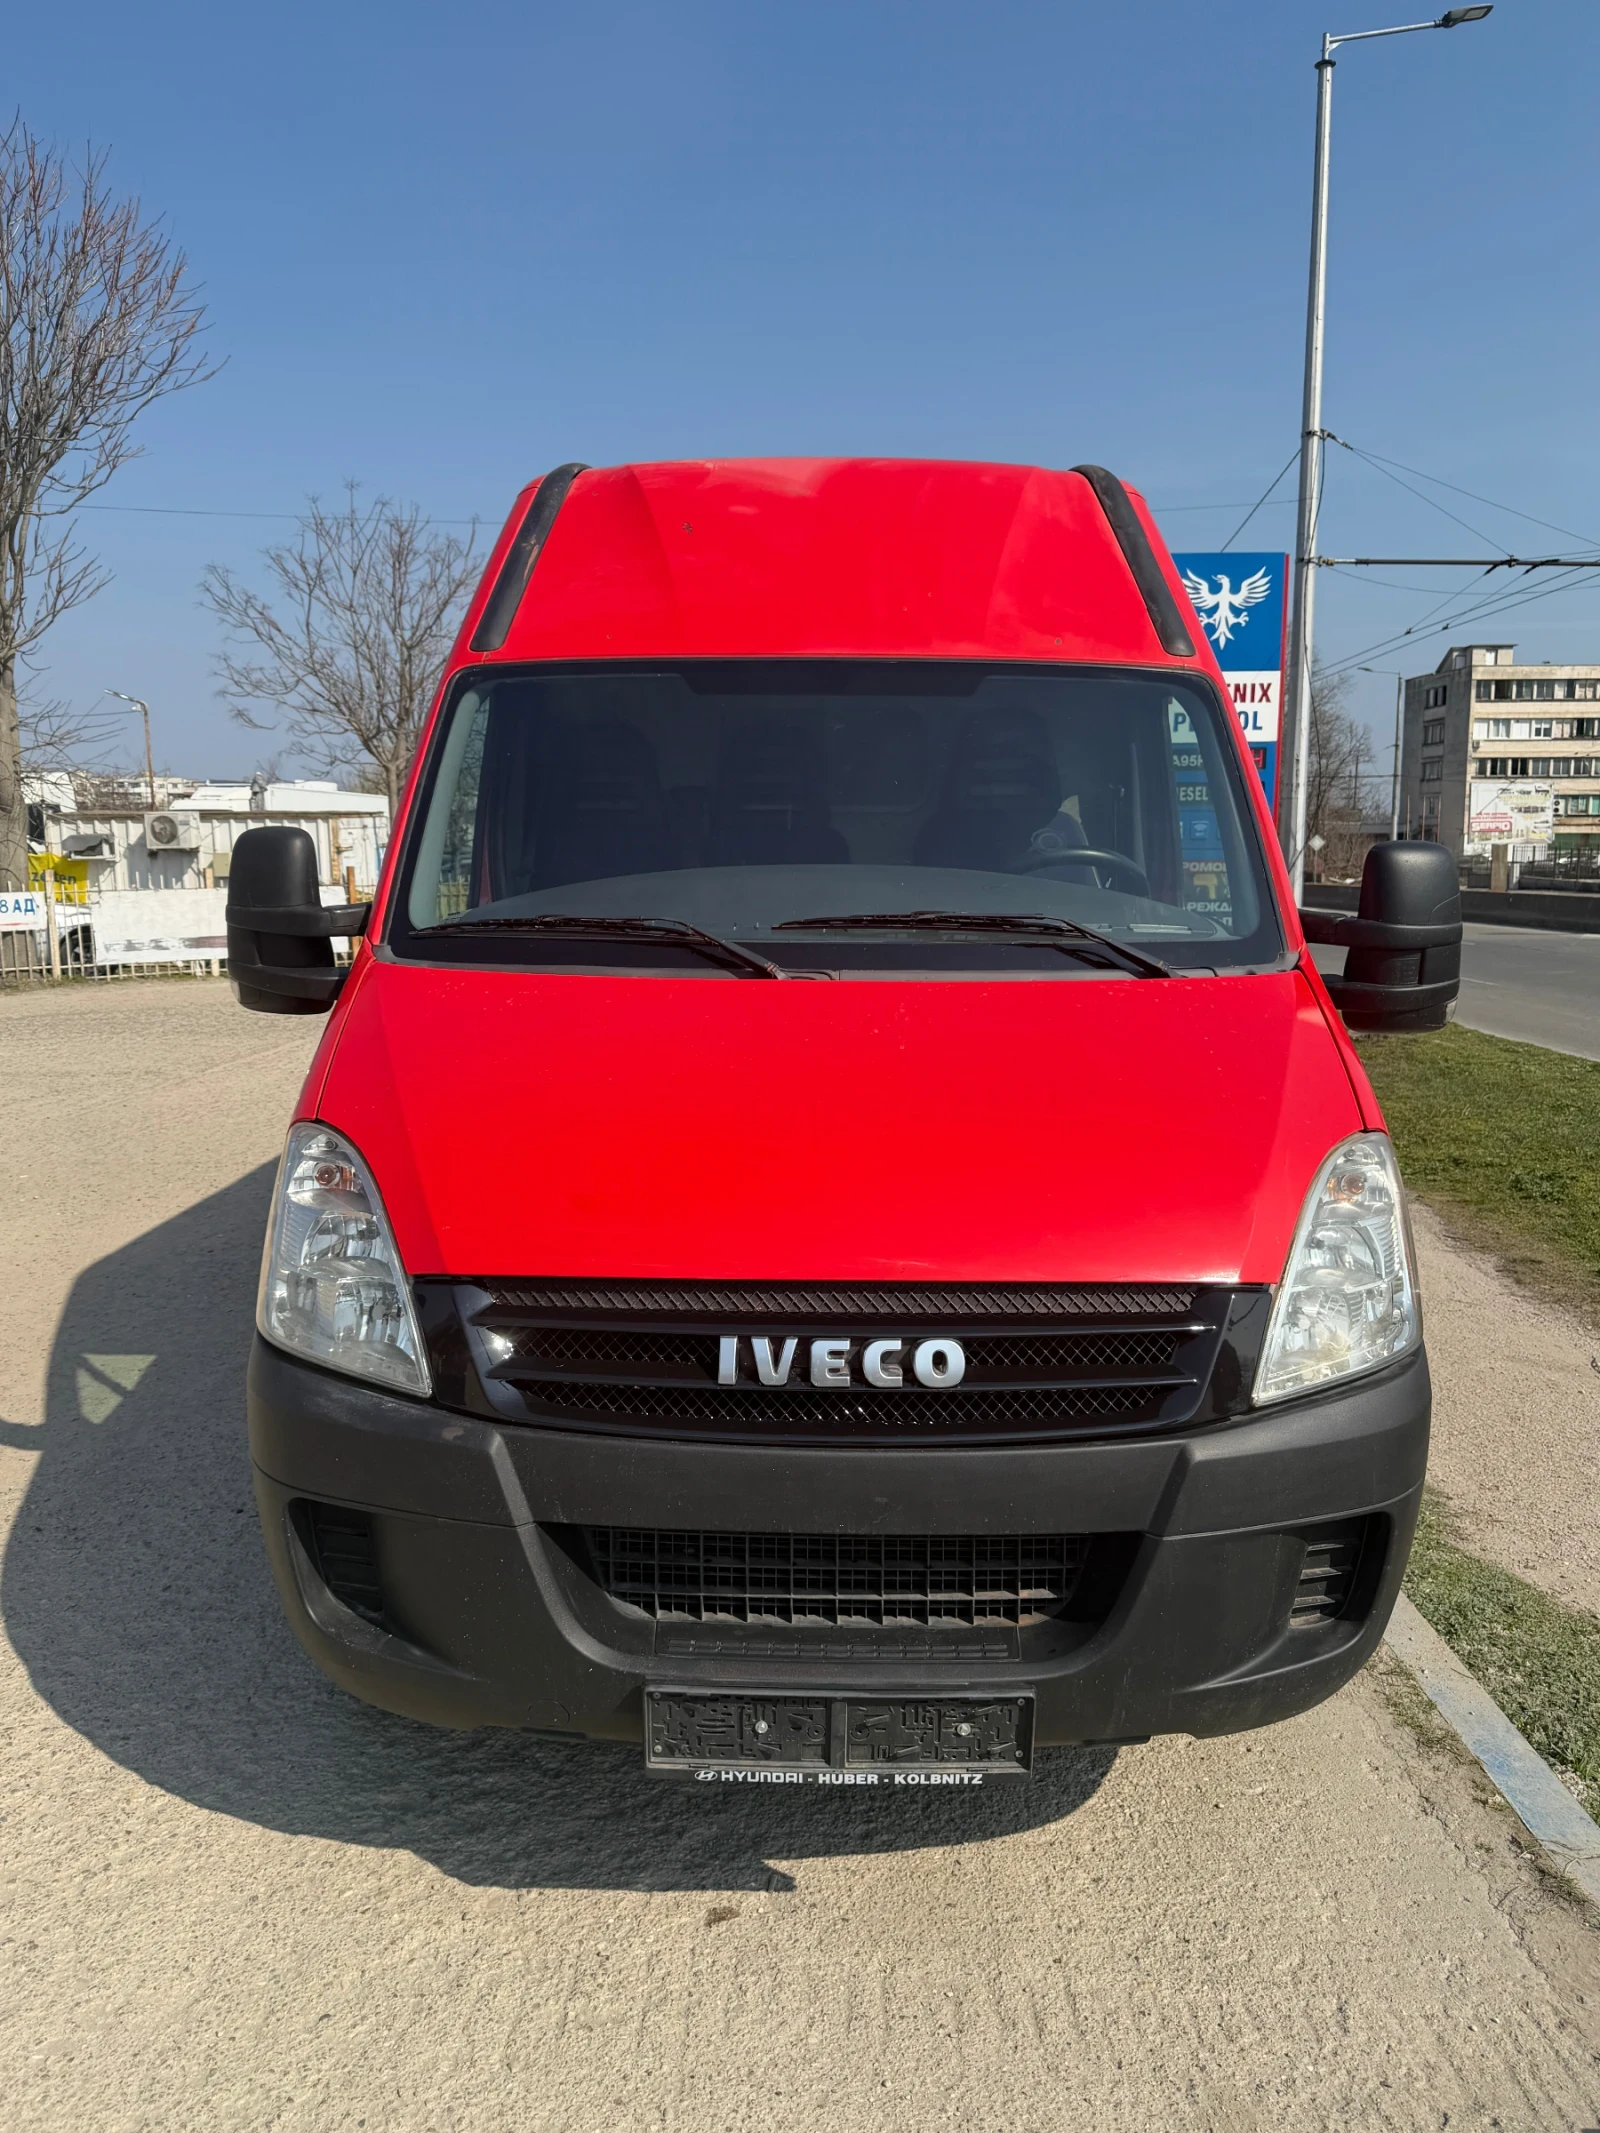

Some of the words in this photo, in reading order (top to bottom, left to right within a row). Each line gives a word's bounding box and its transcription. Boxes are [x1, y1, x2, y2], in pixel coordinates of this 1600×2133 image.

[1176, 786, 1209, 801] ESEL
[717, 1335, 967, 1388] IVECO
[721, 1771, 803, 1784] HYUNDAI
[818, 1774, 878, 1785] HUBER
